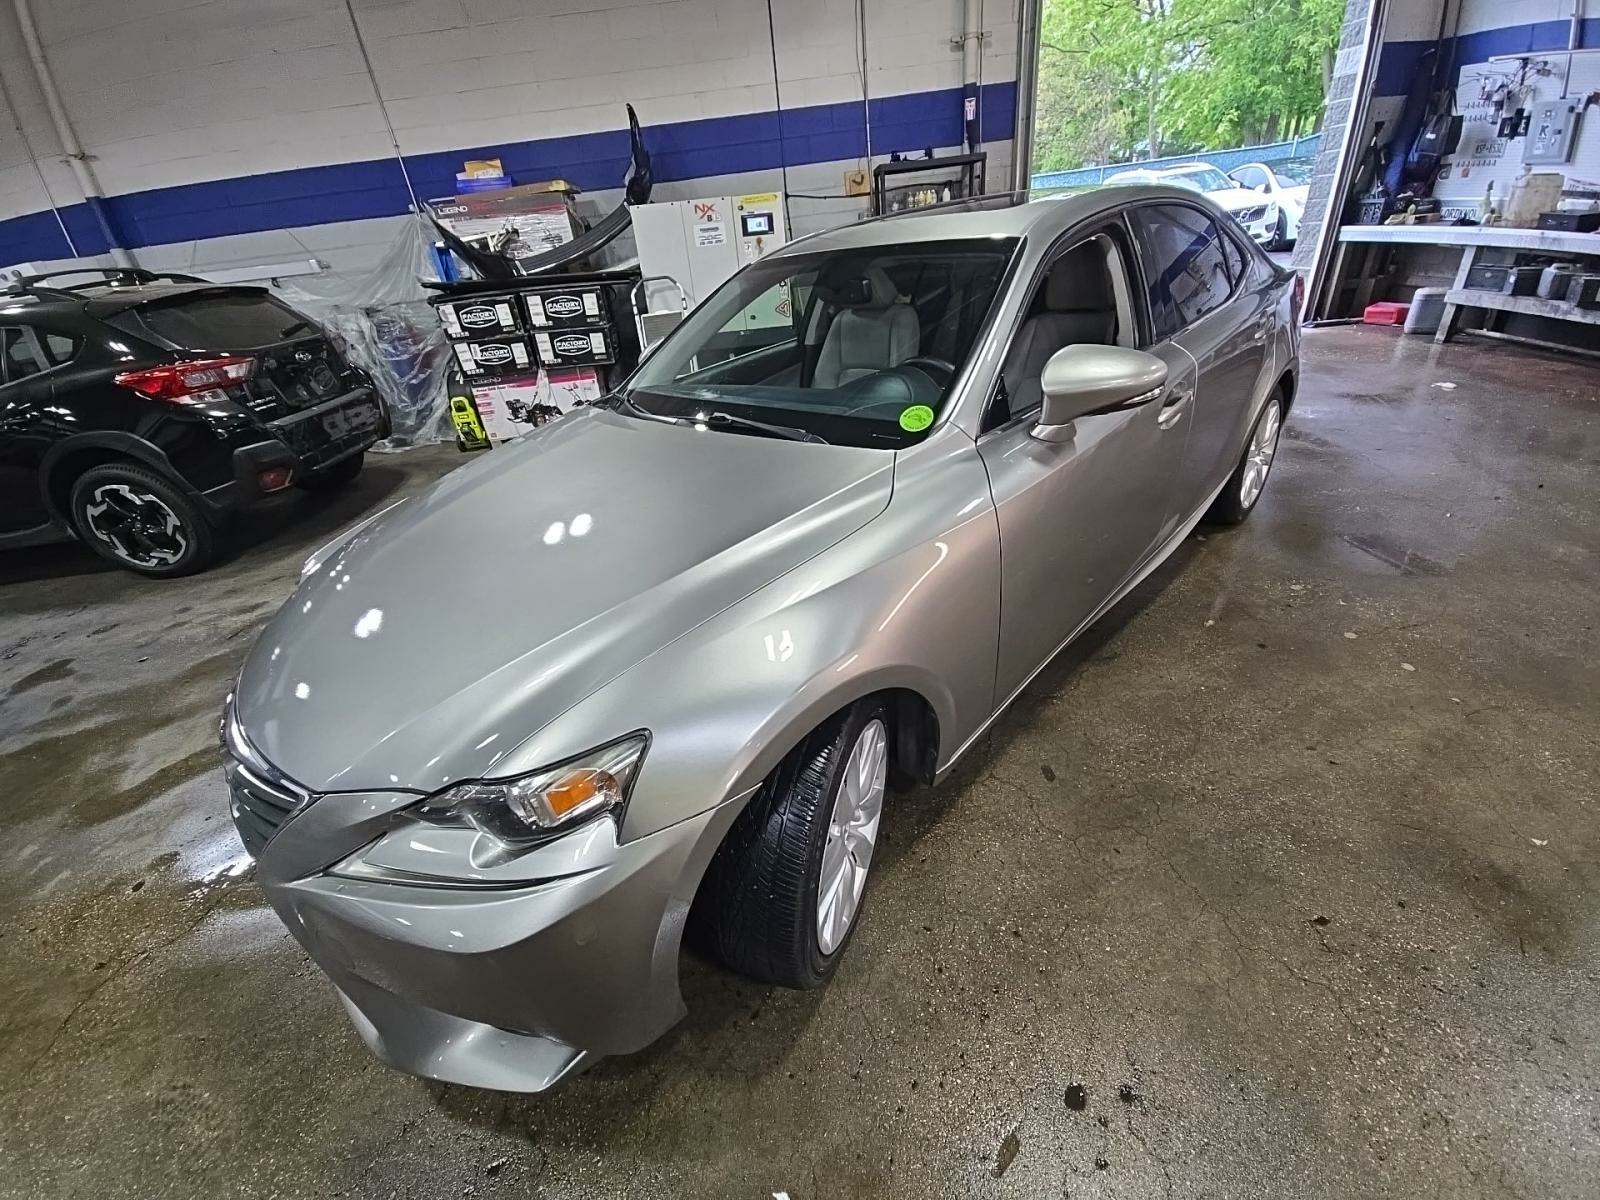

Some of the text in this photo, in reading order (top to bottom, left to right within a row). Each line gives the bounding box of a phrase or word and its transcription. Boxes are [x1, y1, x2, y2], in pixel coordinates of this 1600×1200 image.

[437, 205, 468, 215] LEGEND
[694, 203, 716, 219] NX
[547, 301, 580, 310] FACTORY
[462, 311, 495, 320] FACTORY
[556, 340, 588, 348] FACTORY
